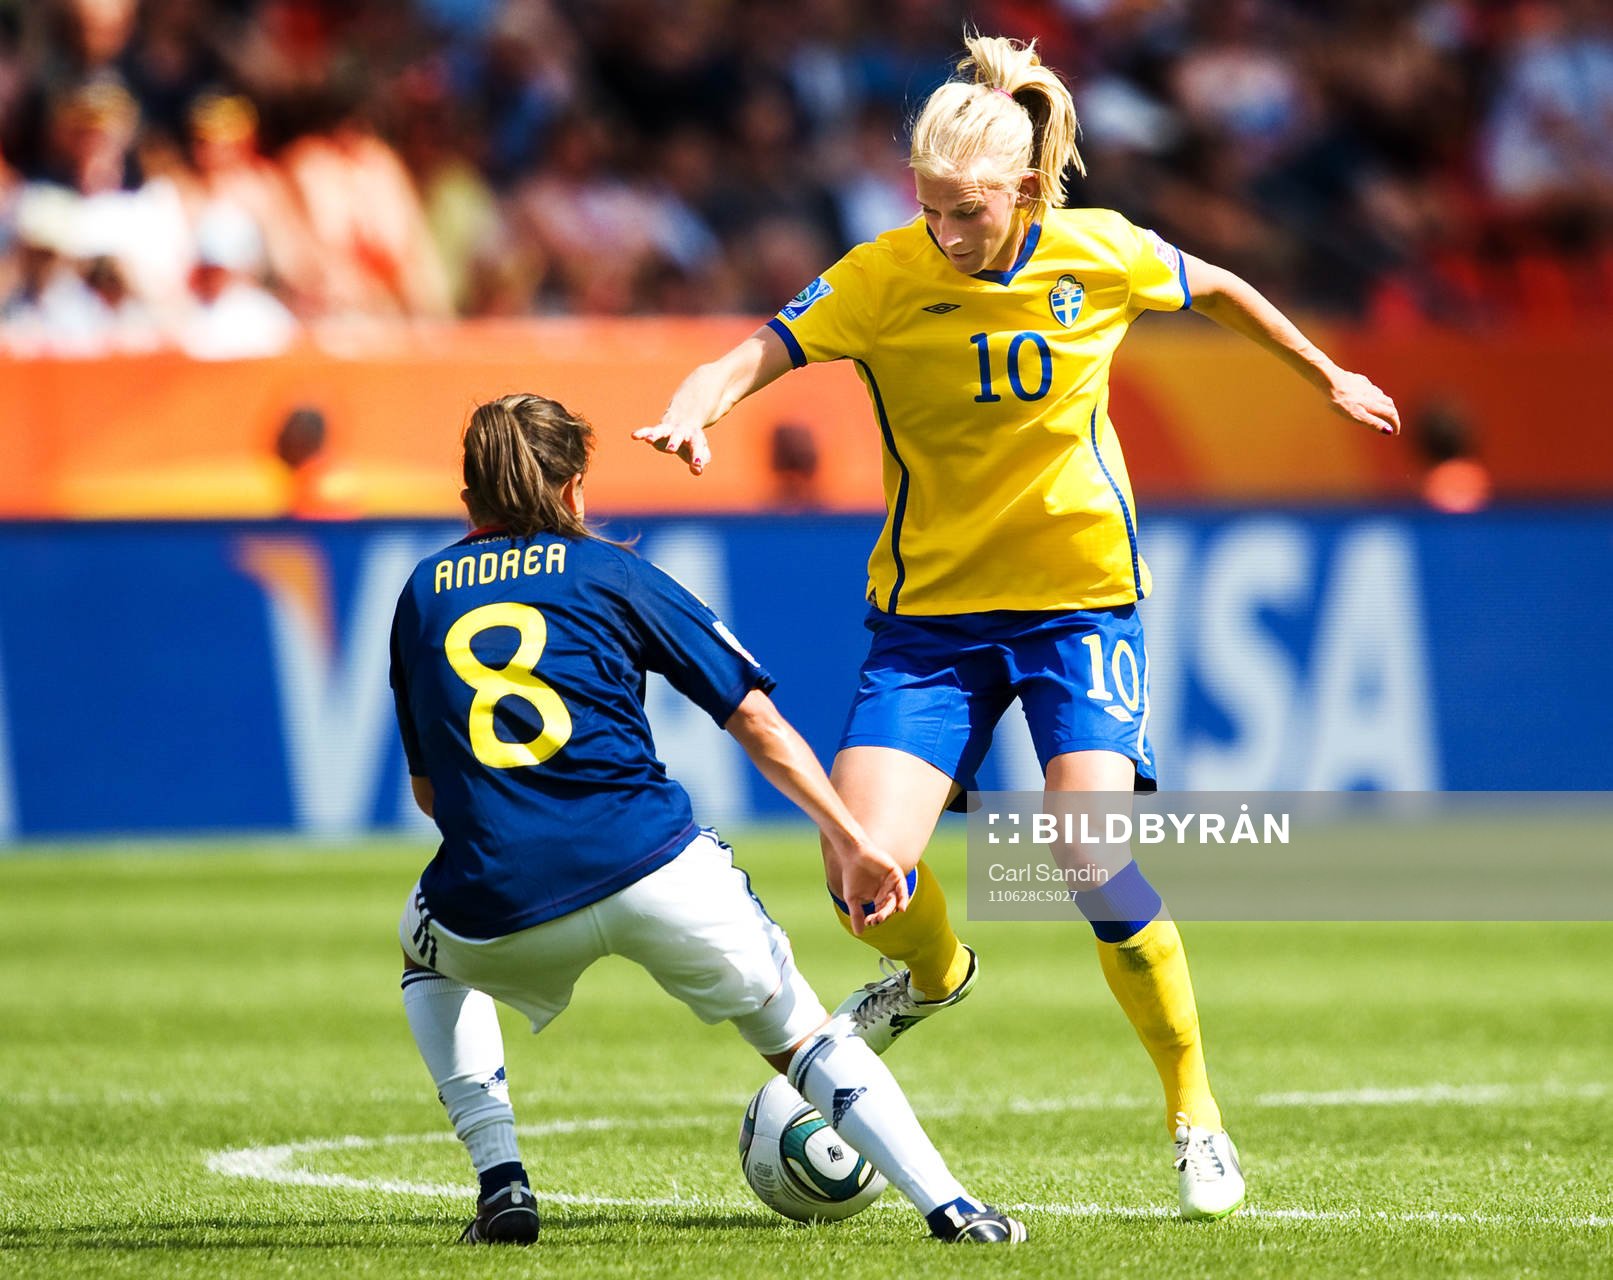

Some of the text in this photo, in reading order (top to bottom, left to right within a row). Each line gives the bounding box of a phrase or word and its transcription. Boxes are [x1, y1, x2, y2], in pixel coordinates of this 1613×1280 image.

[970, 331, 1053, 403] 10
[434, 543, 567, 594] ANDREA
[444, 602, 573, 769] 8
[1081, 633, 1140, 712] 10
